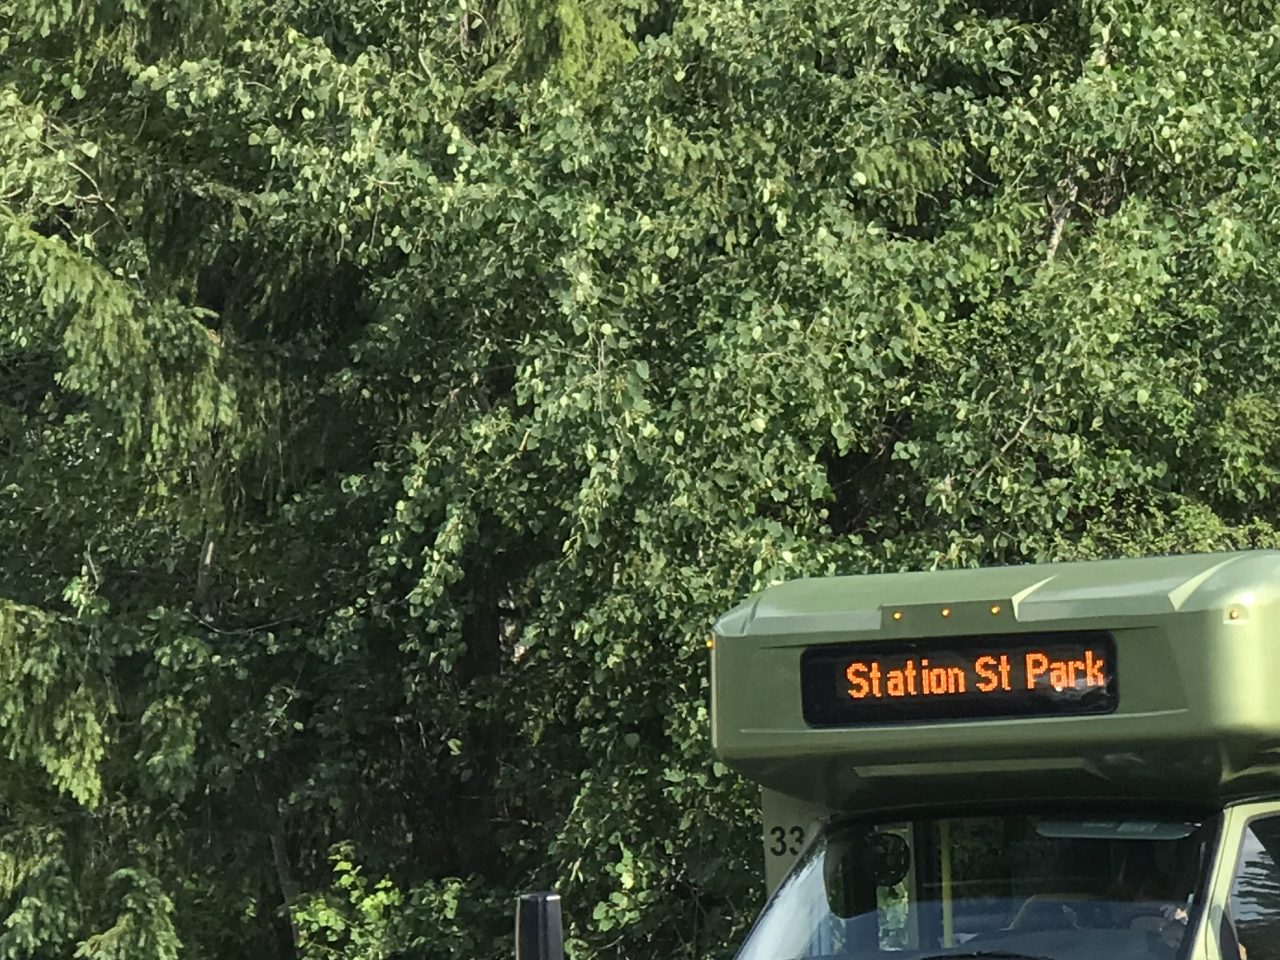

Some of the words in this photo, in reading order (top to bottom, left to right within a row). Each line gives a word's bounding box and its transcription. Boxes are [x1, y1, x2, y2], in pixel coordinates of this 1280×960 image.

[846, 659, 966, 699] Station
[975, 655, 1011, 692] St
[1025, 650, 1105, 690] Park
[770, 825, 805, 857] 33
